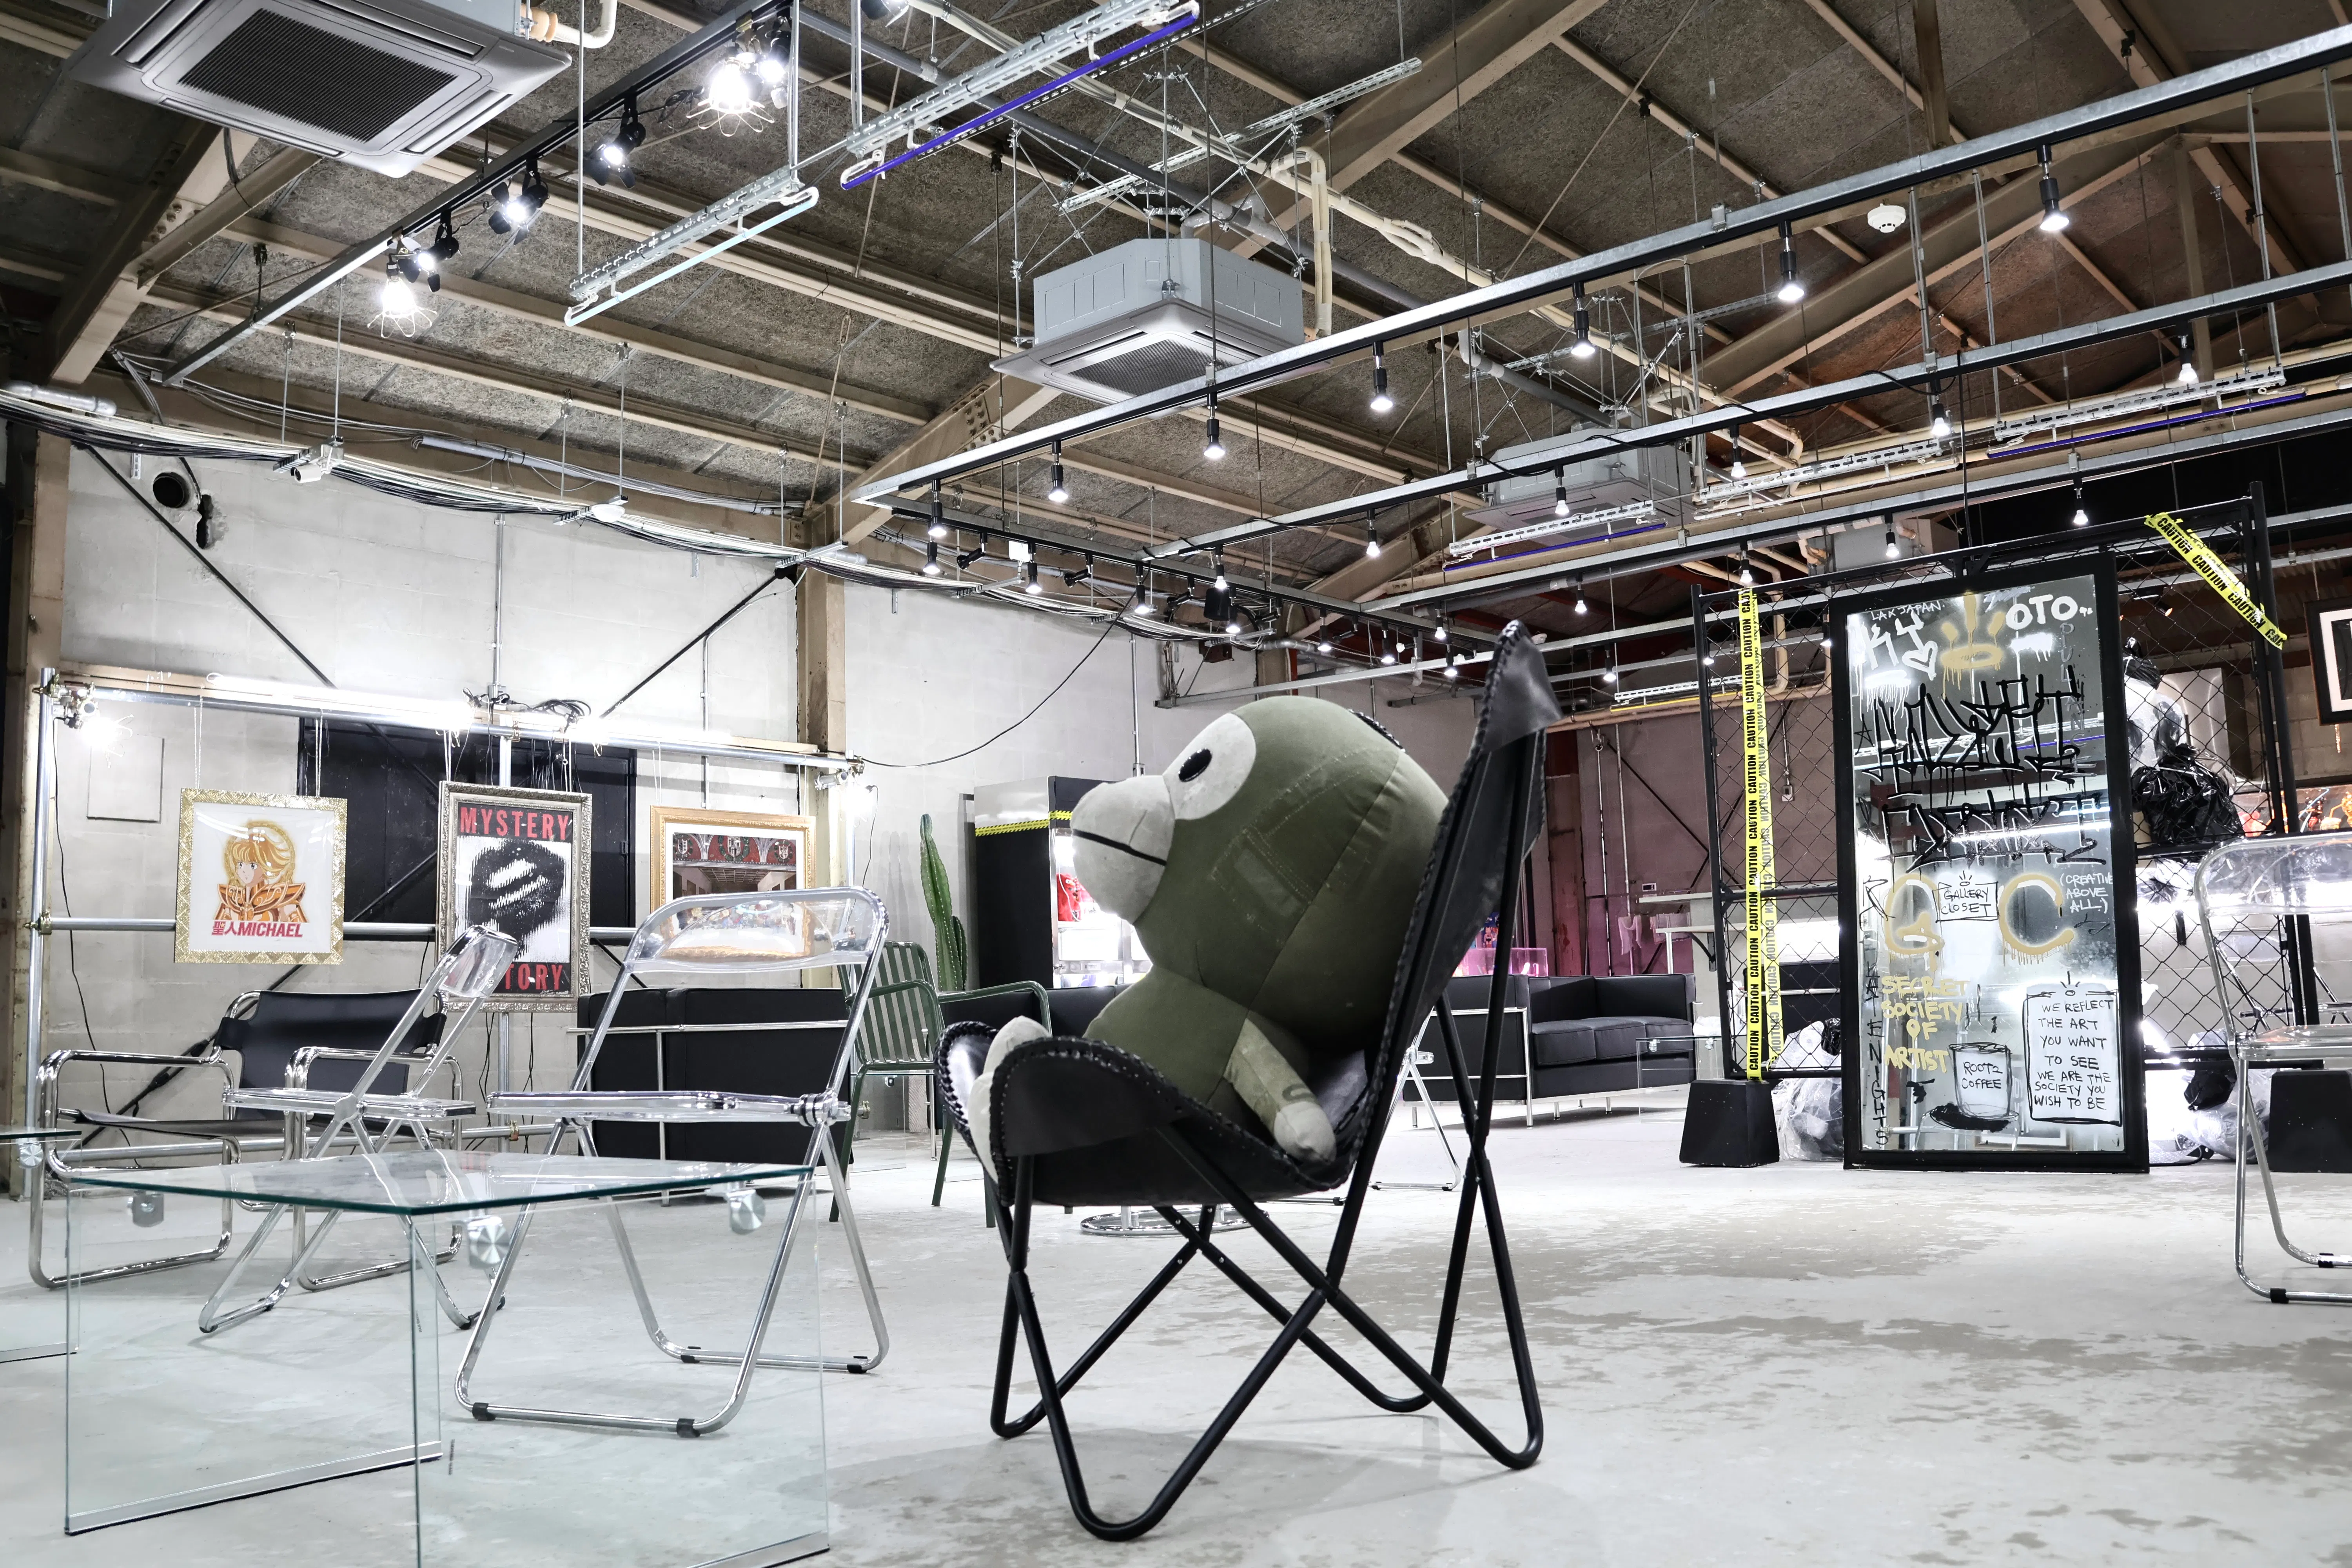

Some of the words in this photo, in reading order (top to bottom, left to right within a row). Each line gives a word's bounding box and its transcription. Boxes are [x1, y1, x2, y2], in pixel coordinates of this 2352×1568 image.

[2157, 518, 2193, 554] CAUTION
[2192, 554, 2227, 591] CAUTION
[2227, 592, 2266, 629] CAUTION
[1742, 619, 1753, 658] CAUTION
[1745, 664, 1754, 703] CAUTION
[1746, 709, 1756, 748] CAUTION
[1748, 755, 1757, 793] CAUTION
[460, 807, 569, 840] MYSTERY
[1749, 800, 1757, 839] CAUTION
[1749, 846, 1758, 885] CAUTION
[1944, 887, 1988, 902] GALLERY
[2065, 887, 2109, 899] ABOVE
[1749, 892, 1758, 931] CAUTION
[1941, 902, 1991, 917] CLOSET
[1750, 938, 1759, 978] CAUTION
[504, 963, 563, 991] TORY
[1881, 975, 1970, 998] SECRET
[1750, 984, 1759, 1024] CAUTION
[1880, 1000, 1964, 1025] SOCIETY
[2041, 1003, 2061, 1013] WE
[2065, 1000, 2114, 1013] REFLECT
[1906, 1018, 1938, 1041] OF
[2038, 1016, 2063, 1028] THE
[2070, 1018, 2098, 1031] ART
[1749, 1030, 1759, 1070] CAUTION
[2040, 1035, 2062, 1049] YOU
[2068, 1035, 2107, 1050] WANT
[1883, 1044, 1949, 1073] ARTIST
[2044, 1055, 2062, 1066] TO
[2070, 1055, 2100, 1070] SEE
[1962, 1078, 2002, 1089] COFFEE
[2034, 1081, 2081, 1097] SOCIETY
[2087, 1085, 2106, 1096] YOU
[2037, 1071, 2055, 1081] WE
[2061, 1070, 2083, 1082] ARE
[2087, 1073, 2111, 1085] THE
[2034, 1095, 2062, 1108] WISH
[2067, 1097, 2082, 1109] TO
[2087, 1096, 2107, 1111] BE
